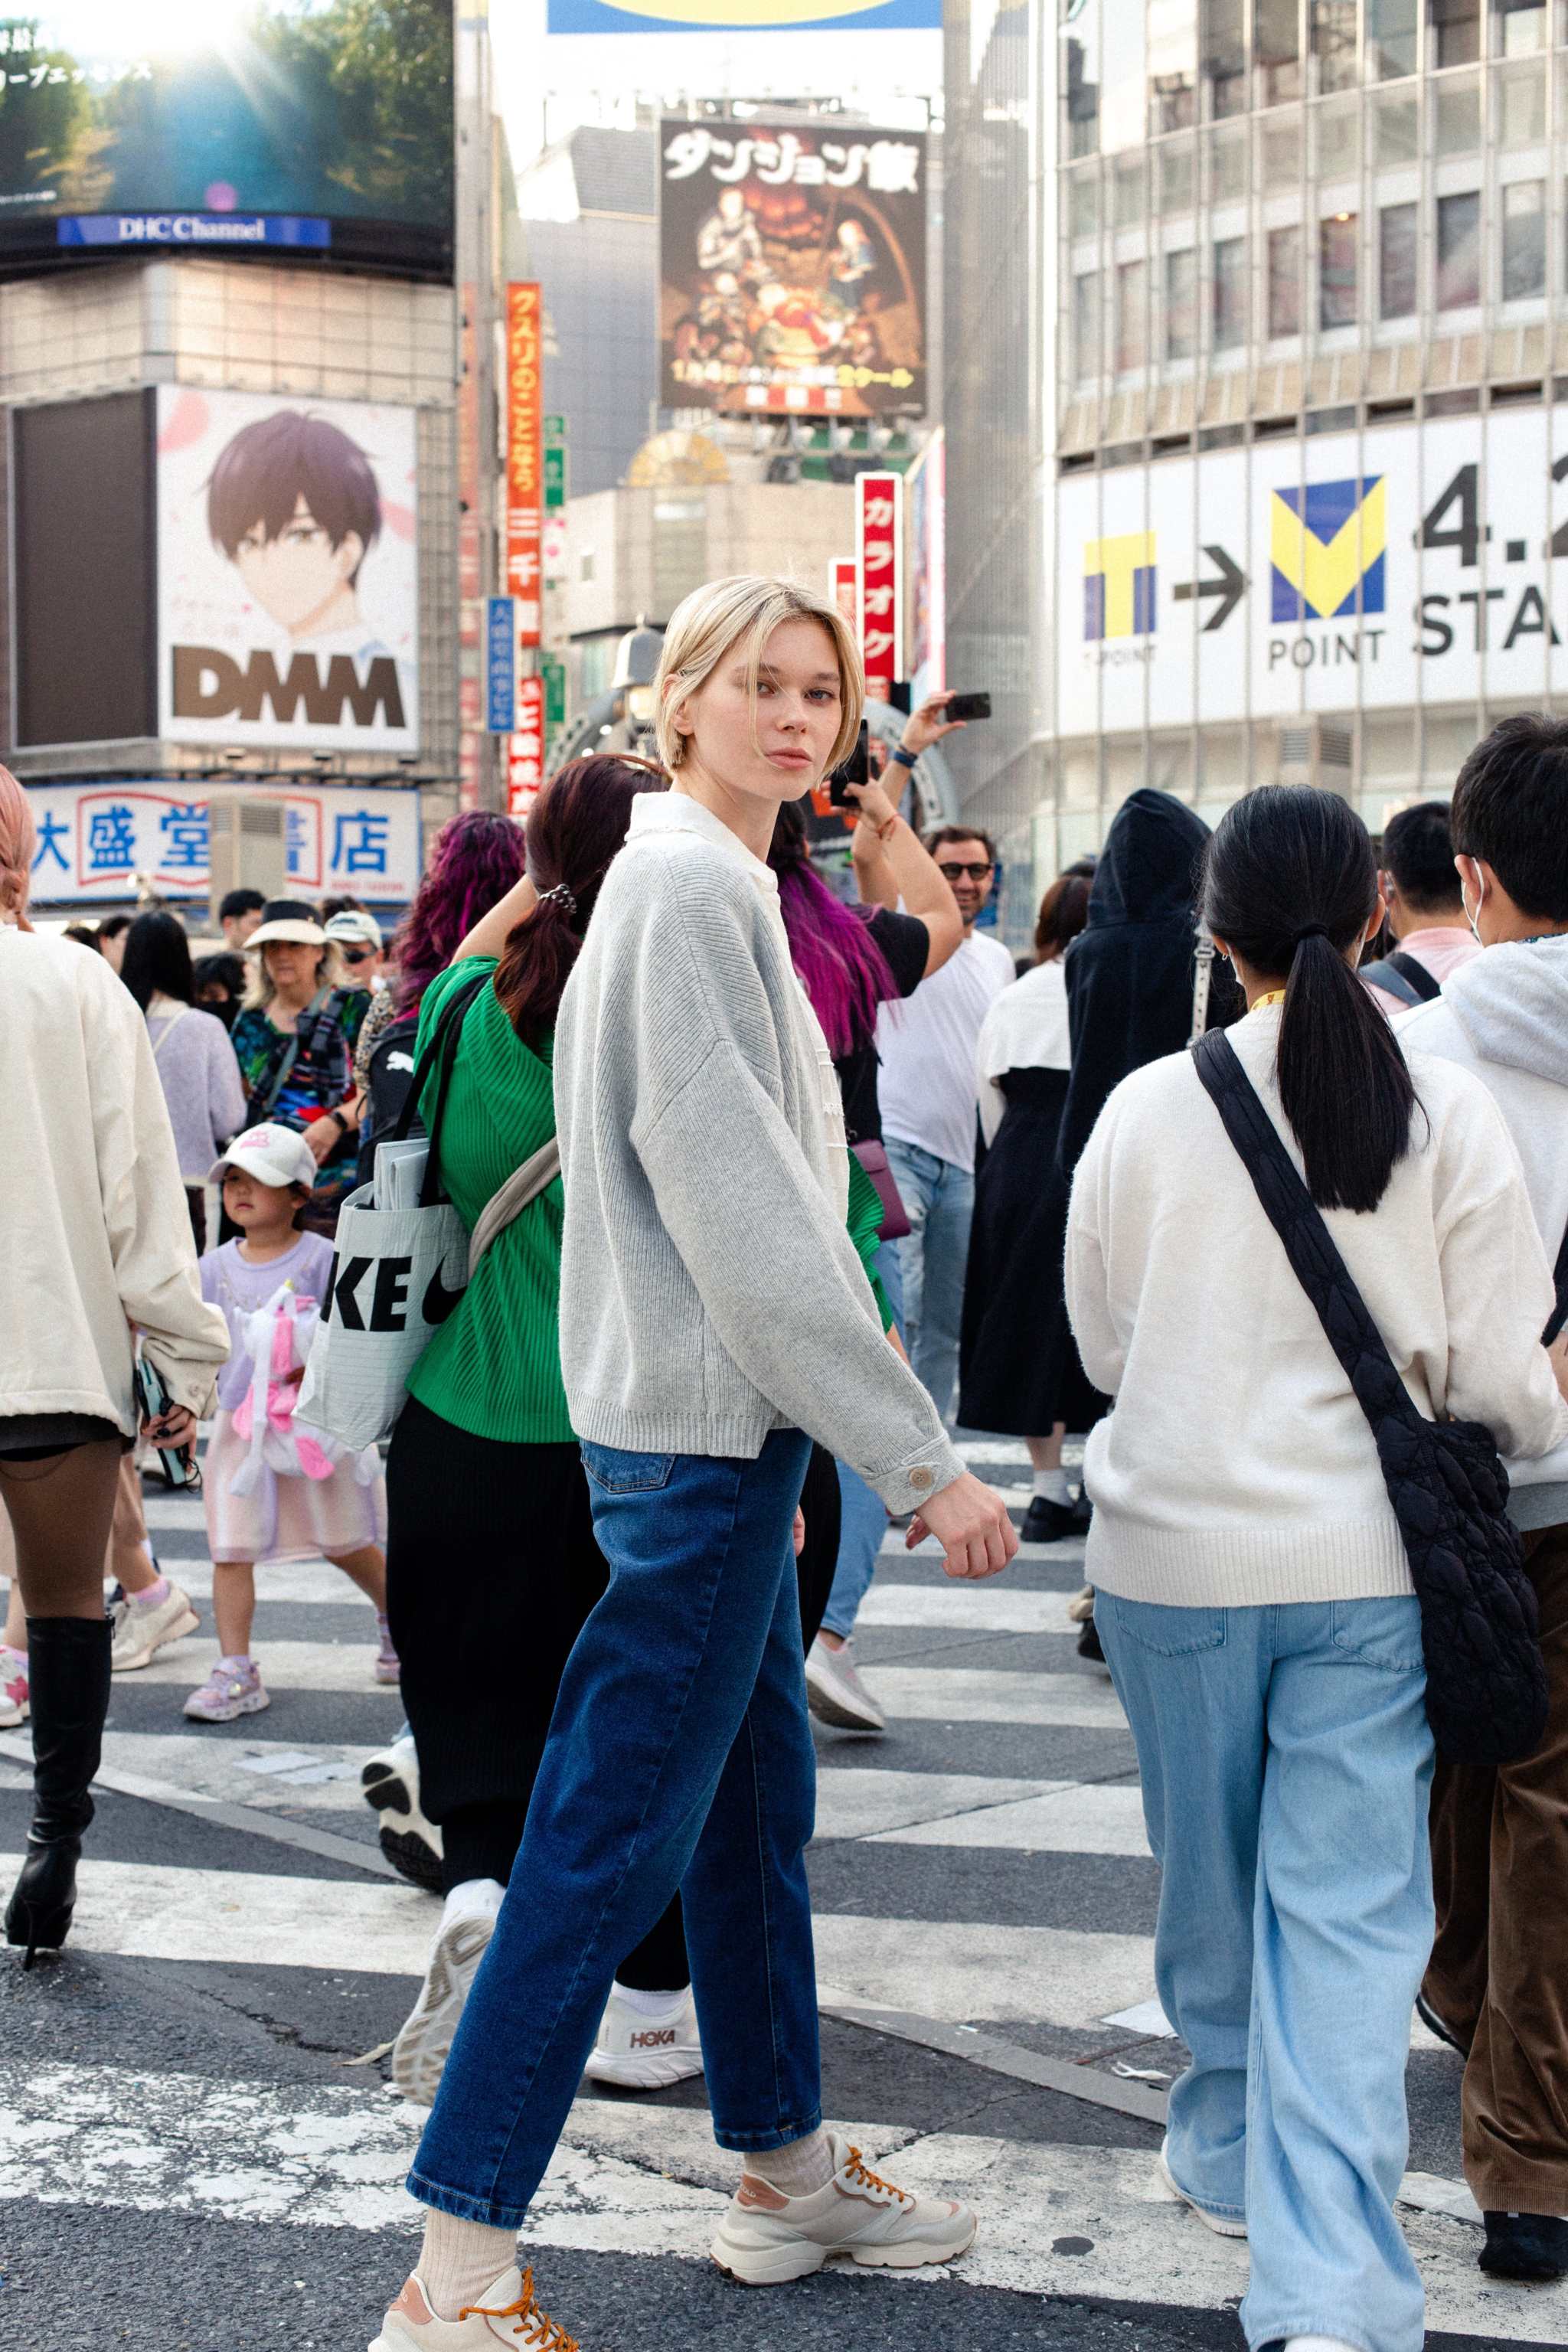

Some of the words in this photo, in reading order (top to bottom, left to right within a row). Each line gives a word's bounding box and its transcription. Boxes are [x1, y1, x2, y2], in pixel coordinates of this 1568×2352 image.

[665, 129, 920, 193] ダンジョン飯
[120, 217, 172, 240] DHC
[172, 217, 265, 240] Channel
[864, 497, 894, 658] カラオケ
[1269, 630, 1386, 671] POINT
[1413, 586, 1561, 655] STA
[172, 645, 407, 728] DMM
[630, 2030, 675, 2049] HOKA
